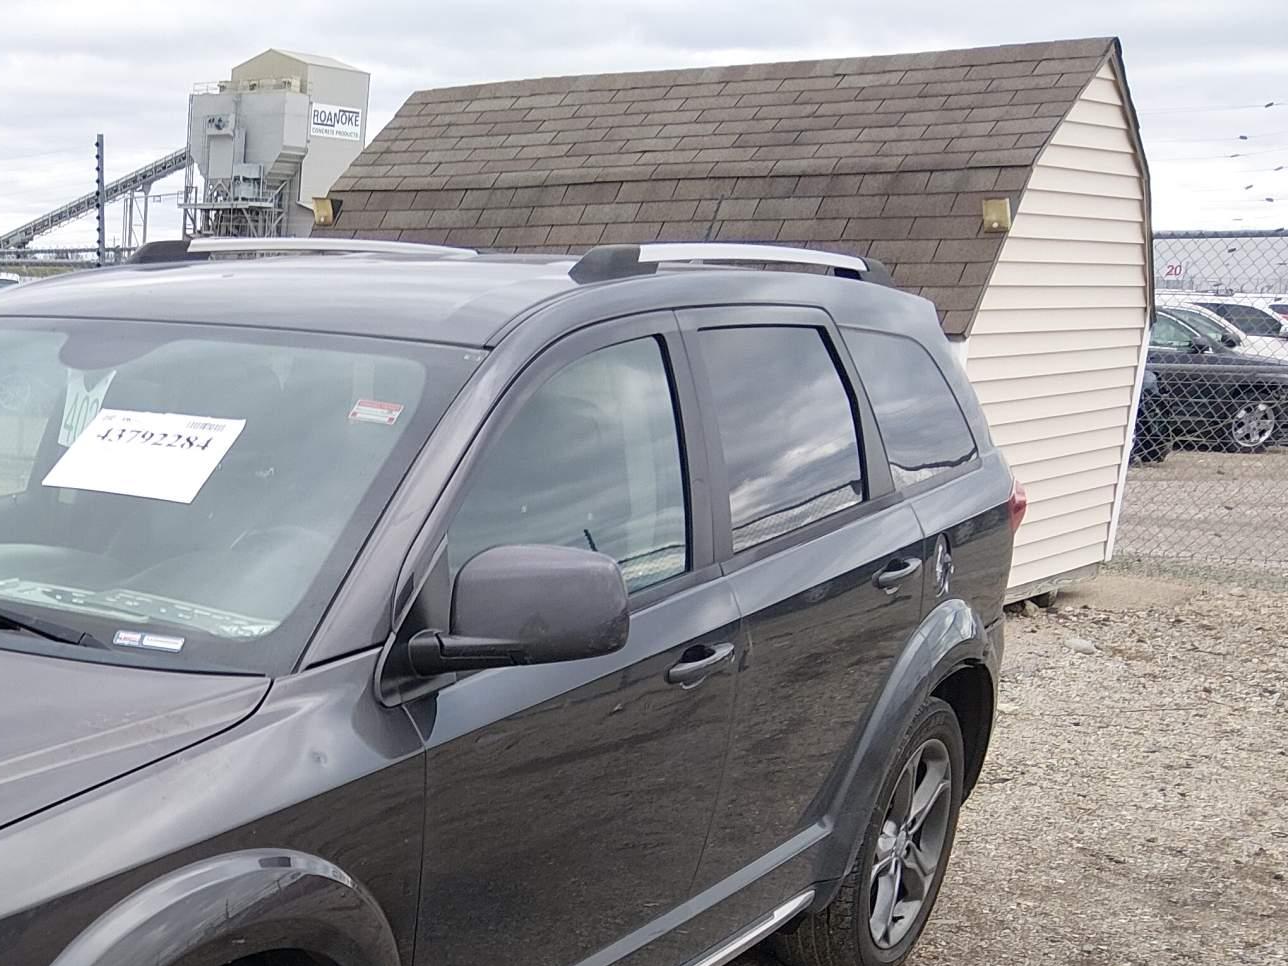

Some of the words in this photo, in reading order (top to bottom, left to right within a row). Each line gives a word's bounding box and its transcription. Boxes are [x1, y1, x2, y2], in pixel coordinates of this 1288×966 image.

[313, 109, 360, 127] ROANOKE
[312, 127, 335, 136] CONCRETE
[335, 130, 359, 138] PRODUCTS
[1165, 264, 1182, 276] 20
[97, 427, 213, 451] 43792284
